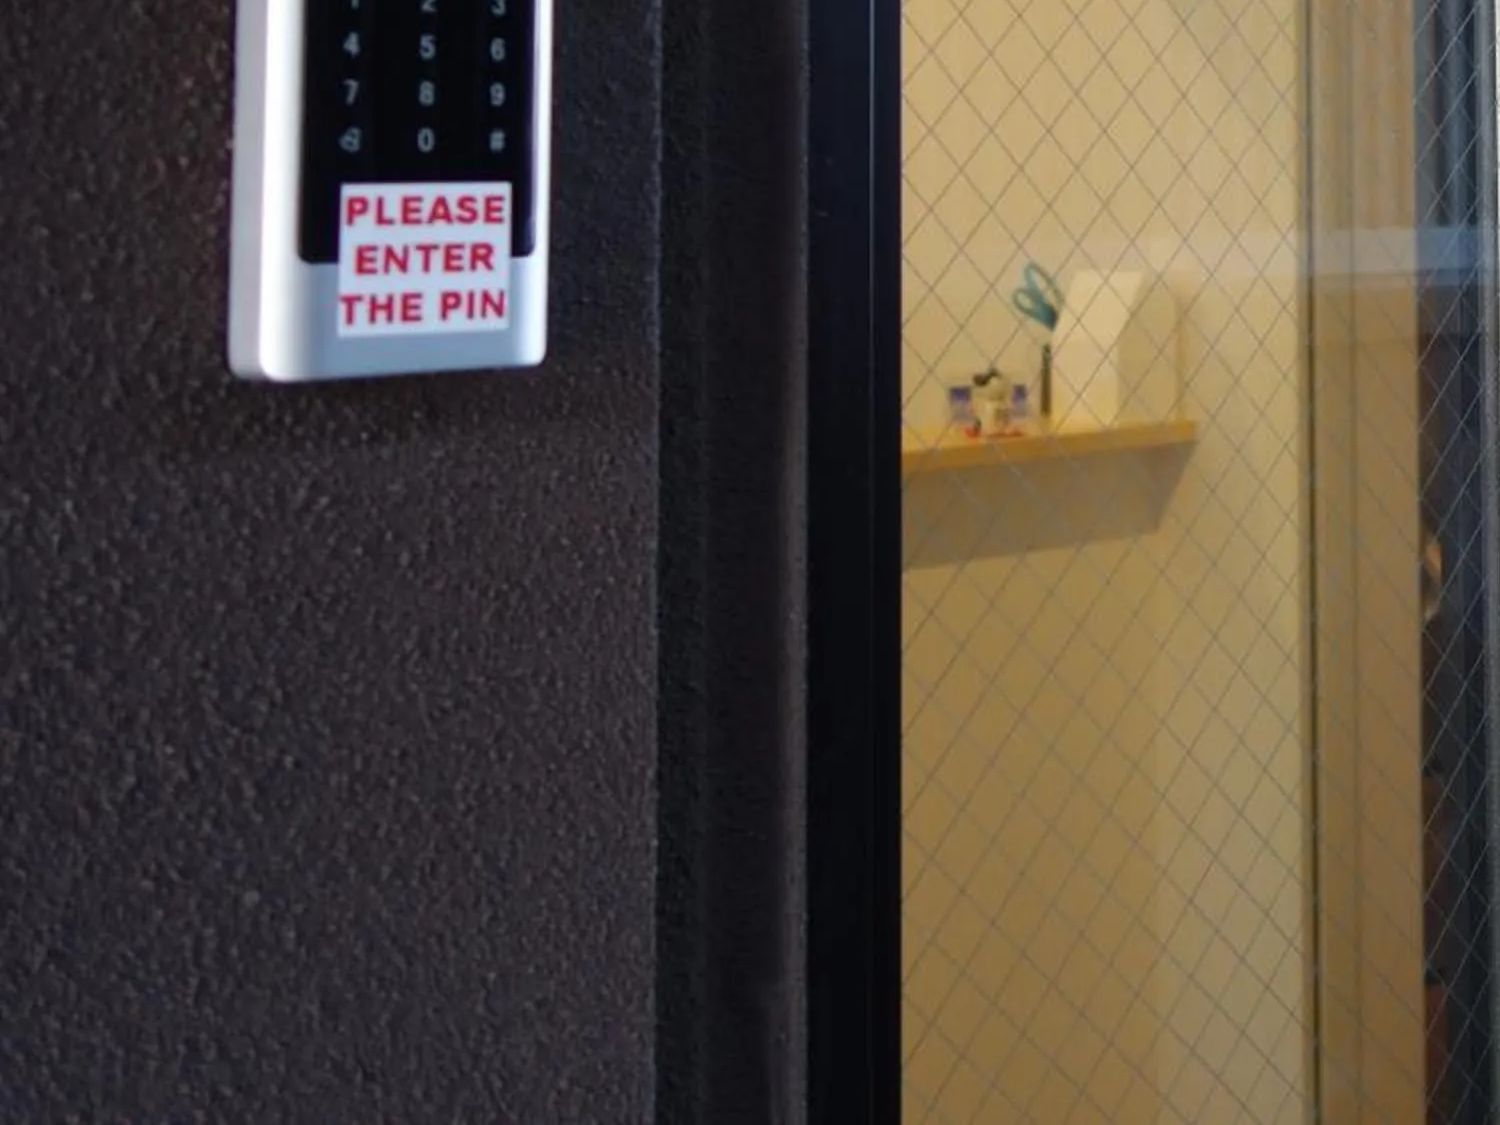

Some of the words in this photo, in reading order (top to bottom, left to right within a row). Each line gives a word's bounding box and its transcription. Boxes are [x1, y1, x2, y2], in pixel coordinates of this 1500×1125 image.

[343, 31, 360, 58] 4
[420, 34, 436, 60] 5
[490, 37, 505, 62] 6
[343, 79, 359, 106] 7
[419, 80, 435, 107] 8
[490, 82, 505, 107] 9
[346, 195, 505, 227] PLEASE
[355, 242, 494, 275] ENTER
[340, 292, 423, 326] THE
[440, 289, 505, 321] PIN
